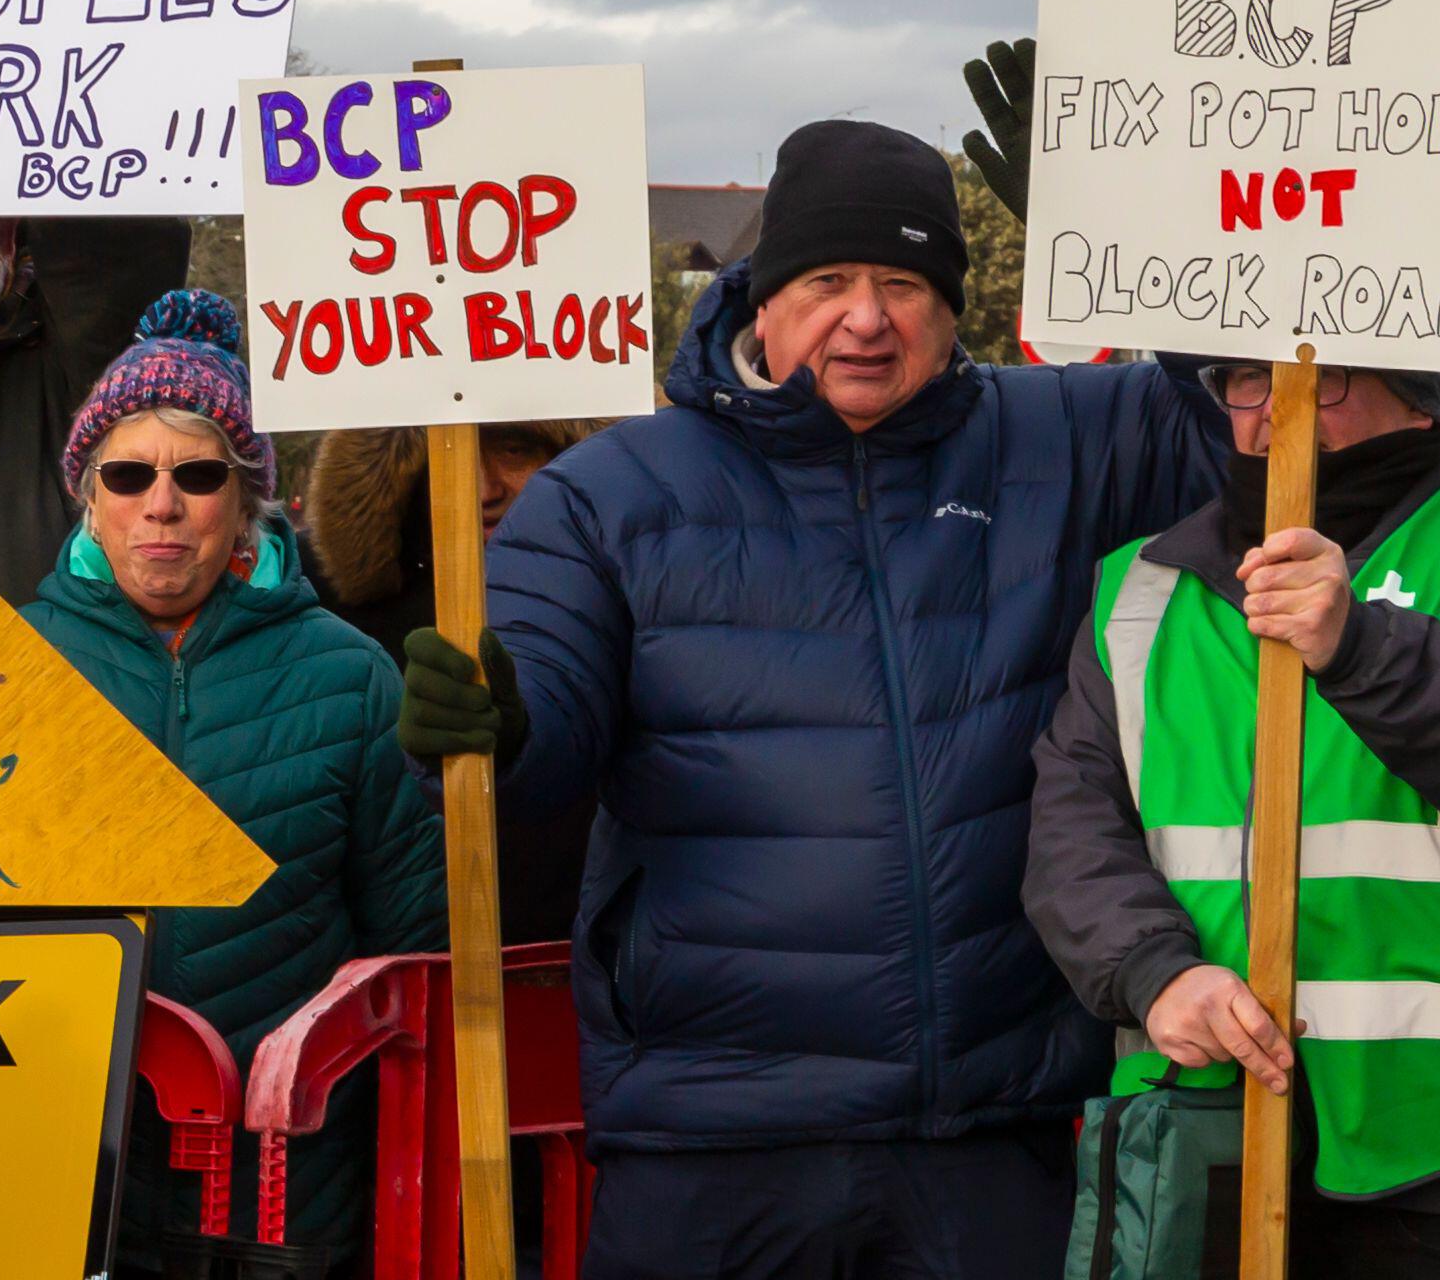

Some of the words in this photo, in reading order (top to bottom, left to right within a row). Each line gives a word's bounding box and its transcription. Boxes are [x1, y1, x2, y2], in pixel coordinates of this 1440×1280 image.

[258, 80, 452, 186] BCP
[1043, 75, 1164, 152] FIX
[1189, 81, 1315, 151] POT
[342, 174, 577, 275] STOP
[1220, 167, 1357, 233] NOT
[1048, 230, 1270, 330] BLOCK
[260, 292, 443, 382] YOUR
[463, 290, 649, 365] BLOCK
